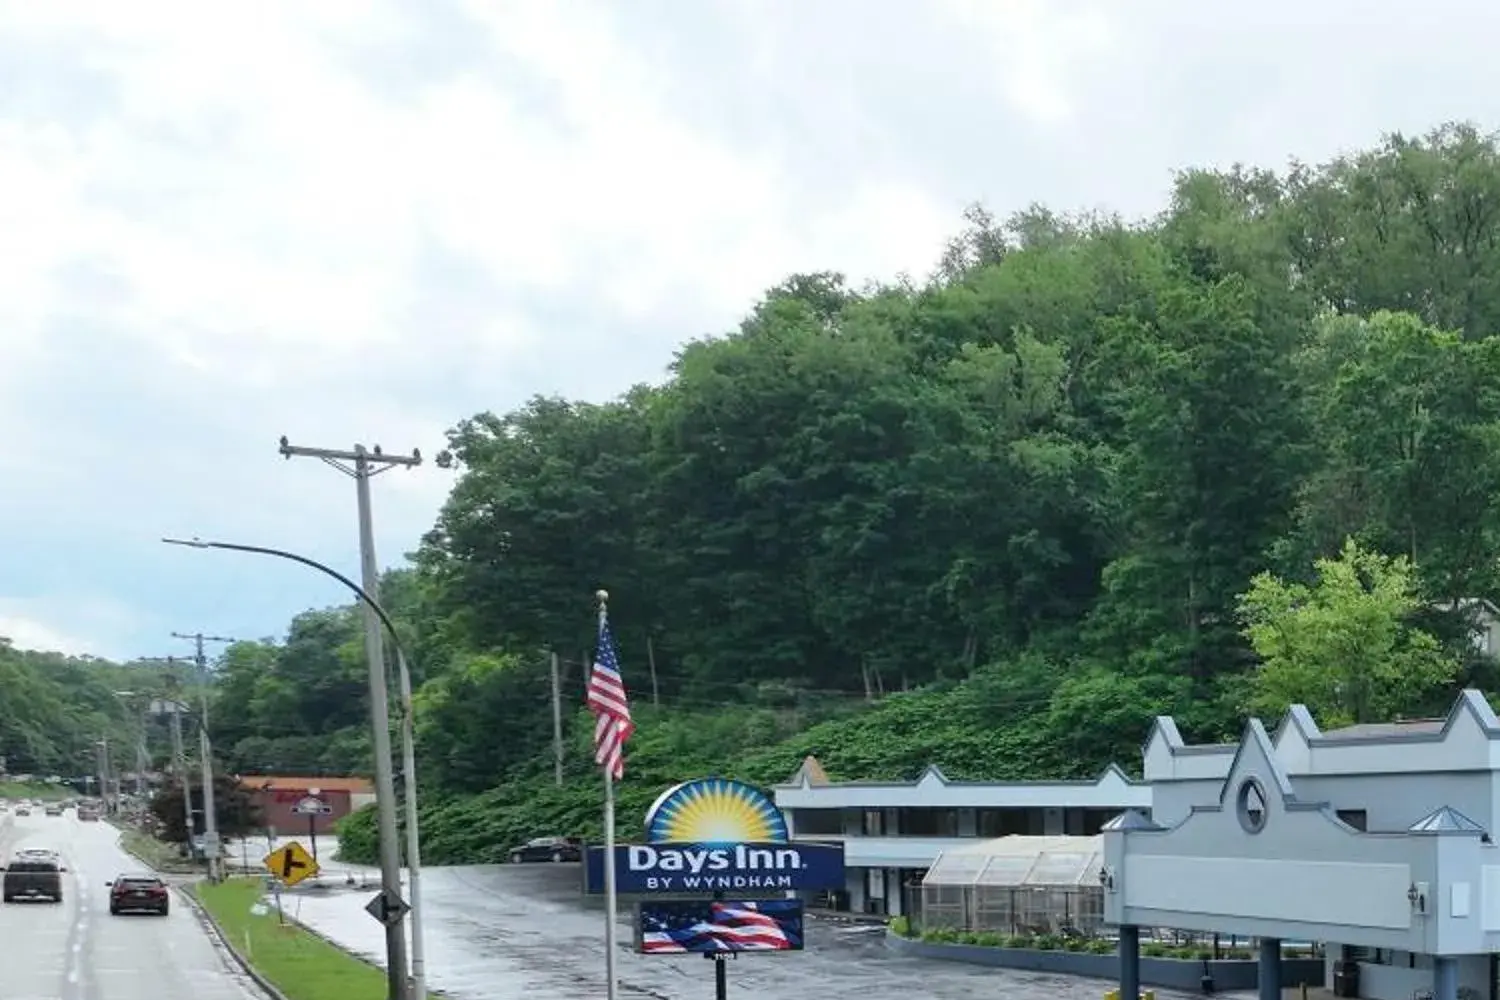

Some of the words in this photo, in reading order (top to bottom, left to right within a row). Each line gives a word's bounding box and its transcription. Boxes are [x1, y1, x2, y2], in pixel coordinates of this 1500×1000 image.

[629, 845, 729, 873] Days
[735, 845, 801, 870] Inn
[647, 877, 672, 889] BY
[684, 876, 791, 889] WYNDHAM
